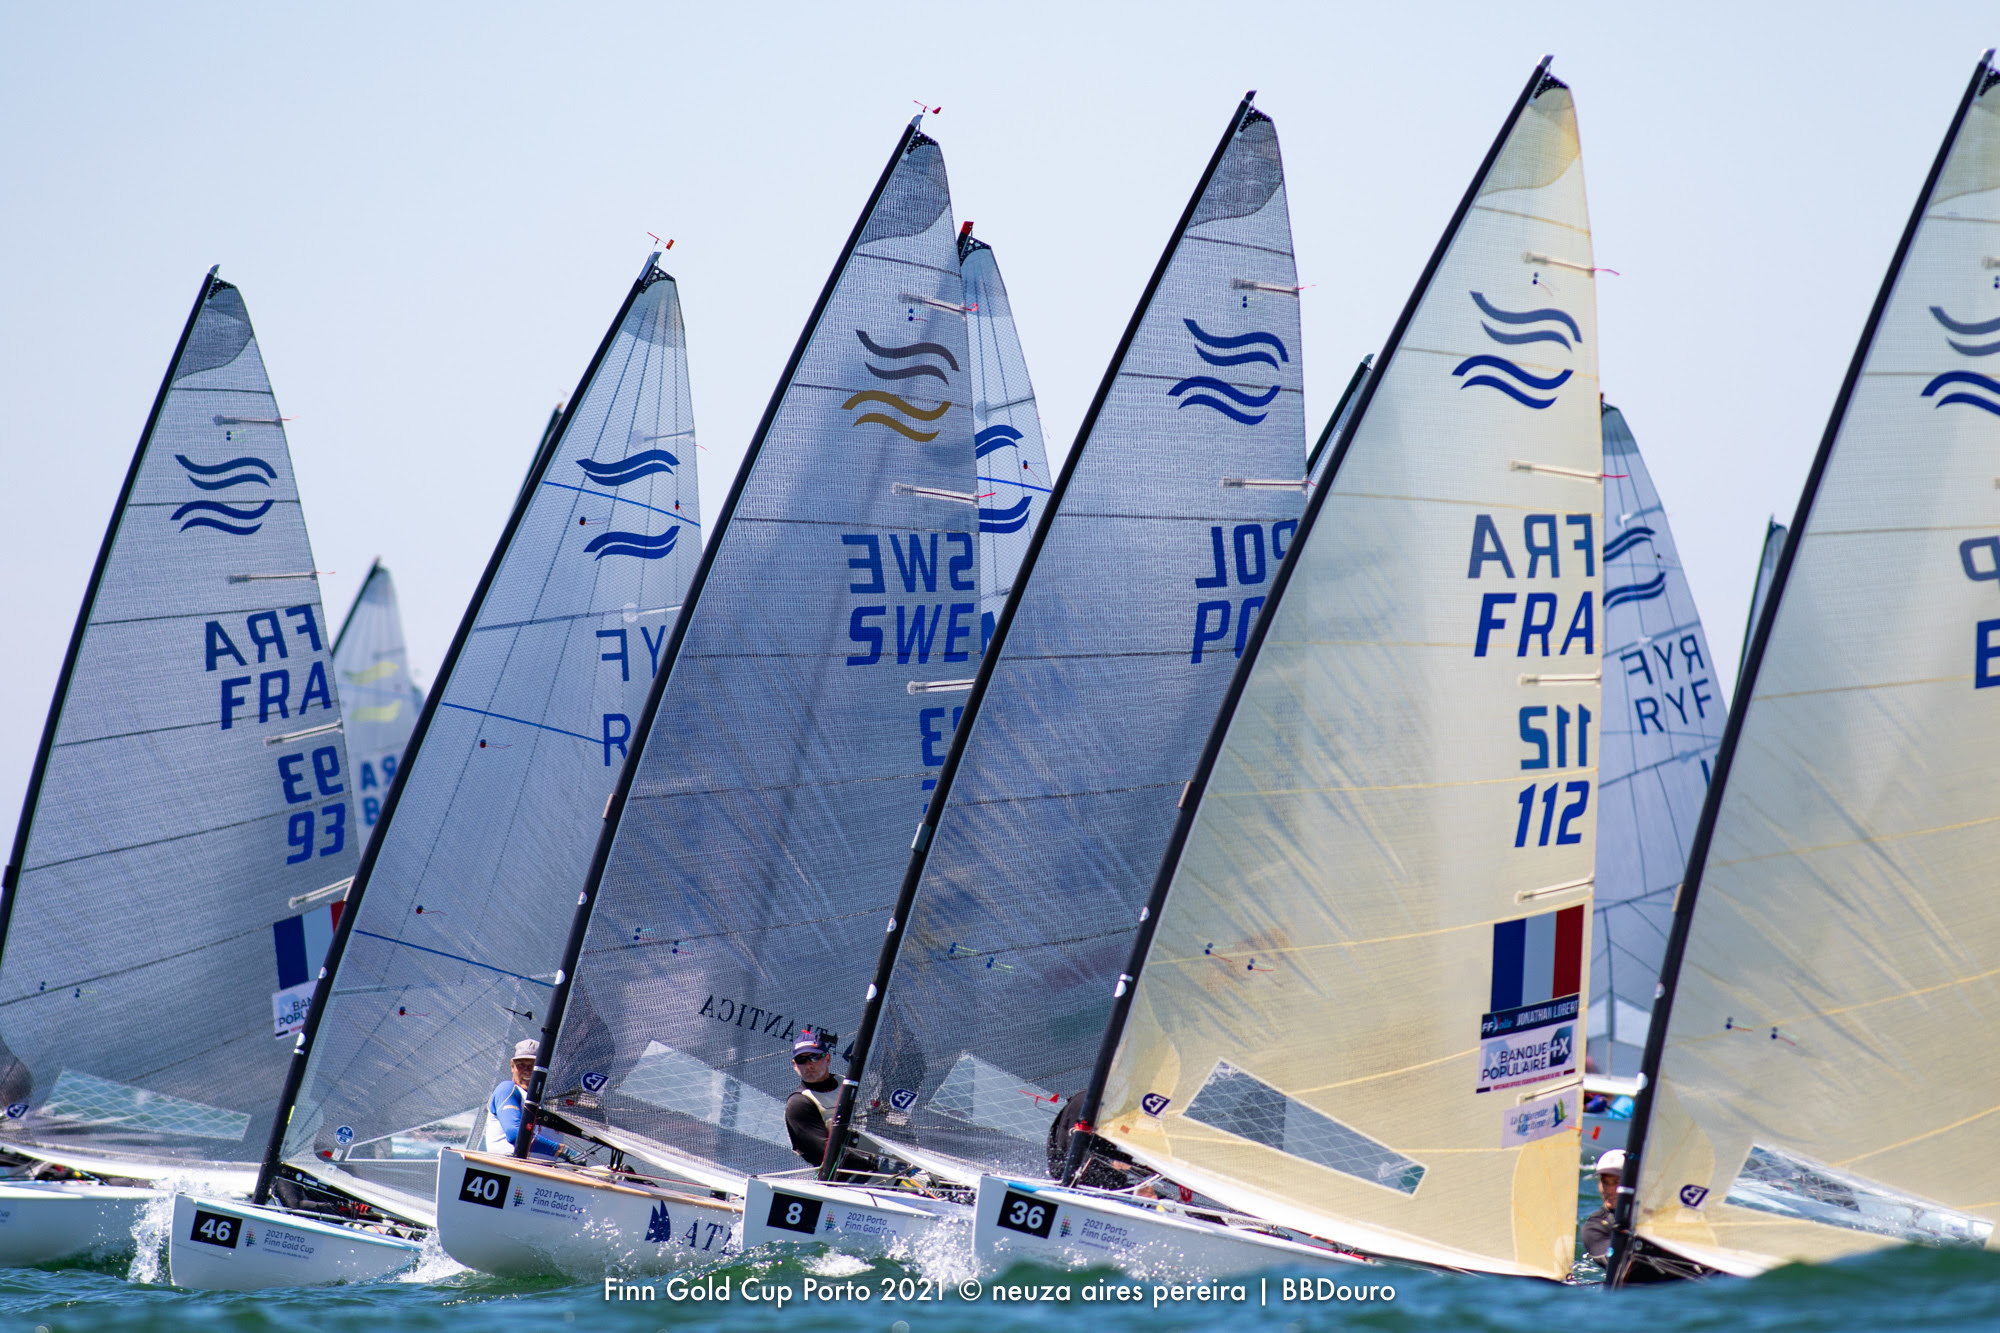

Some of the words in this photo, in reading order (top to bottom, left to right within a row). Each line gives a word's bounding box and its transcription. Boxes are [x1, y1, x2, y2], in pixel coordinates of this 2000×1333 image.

[847, 603, 975, 666] SWE
[1474, 591, 1594, 657] FRA
[221, 660, 332, 730] FRA
[1635, 678, 1711, 735] RYF
[1514, 780, 1590, 848] 112
[286, 802, 346, 865] 93
[1516, 1007, 1552, 1026] JONATHAN
[1500, 1042, 1547, 1064] BANQUE
[1482, 1057, 1546, 1081] POPULAIRE
[466, 1176, 499, 1201] 40
[535, 1188, 552, 1198] 2021
[553, 1191, 574, 1203] Porto
[533, 1197, 549, 1208] Finn
[550, 1199, 567, 1211] Gold
[786, 1203, 803, 1225] 8
[1009, 1201, 1045, 1229] 36
[200, 1218, 232, 1241] 46
[845, 1221, 862, 1231] Finn
[863, 1224, 881, 1235] Gold
[847, 1212, 864, 1222] 2021
[866, 1215, 887, 1226] Porto
[1084, 1218, 1103, 1230] 2021
[1104, 1223, 1128, 1236] Porto
[264, 1237, 280, 1247] Finn
[281, 1240, 299, 1251] Gold
[300, 1245, 314, 1255] Cup
[265, 1229, 283, 1239] 2021
[284, 1232, 305, 1243] Porto
[1081, 1227, 1099, 1240] Finn
[1100, 1231, 1120, 1244] Gold
